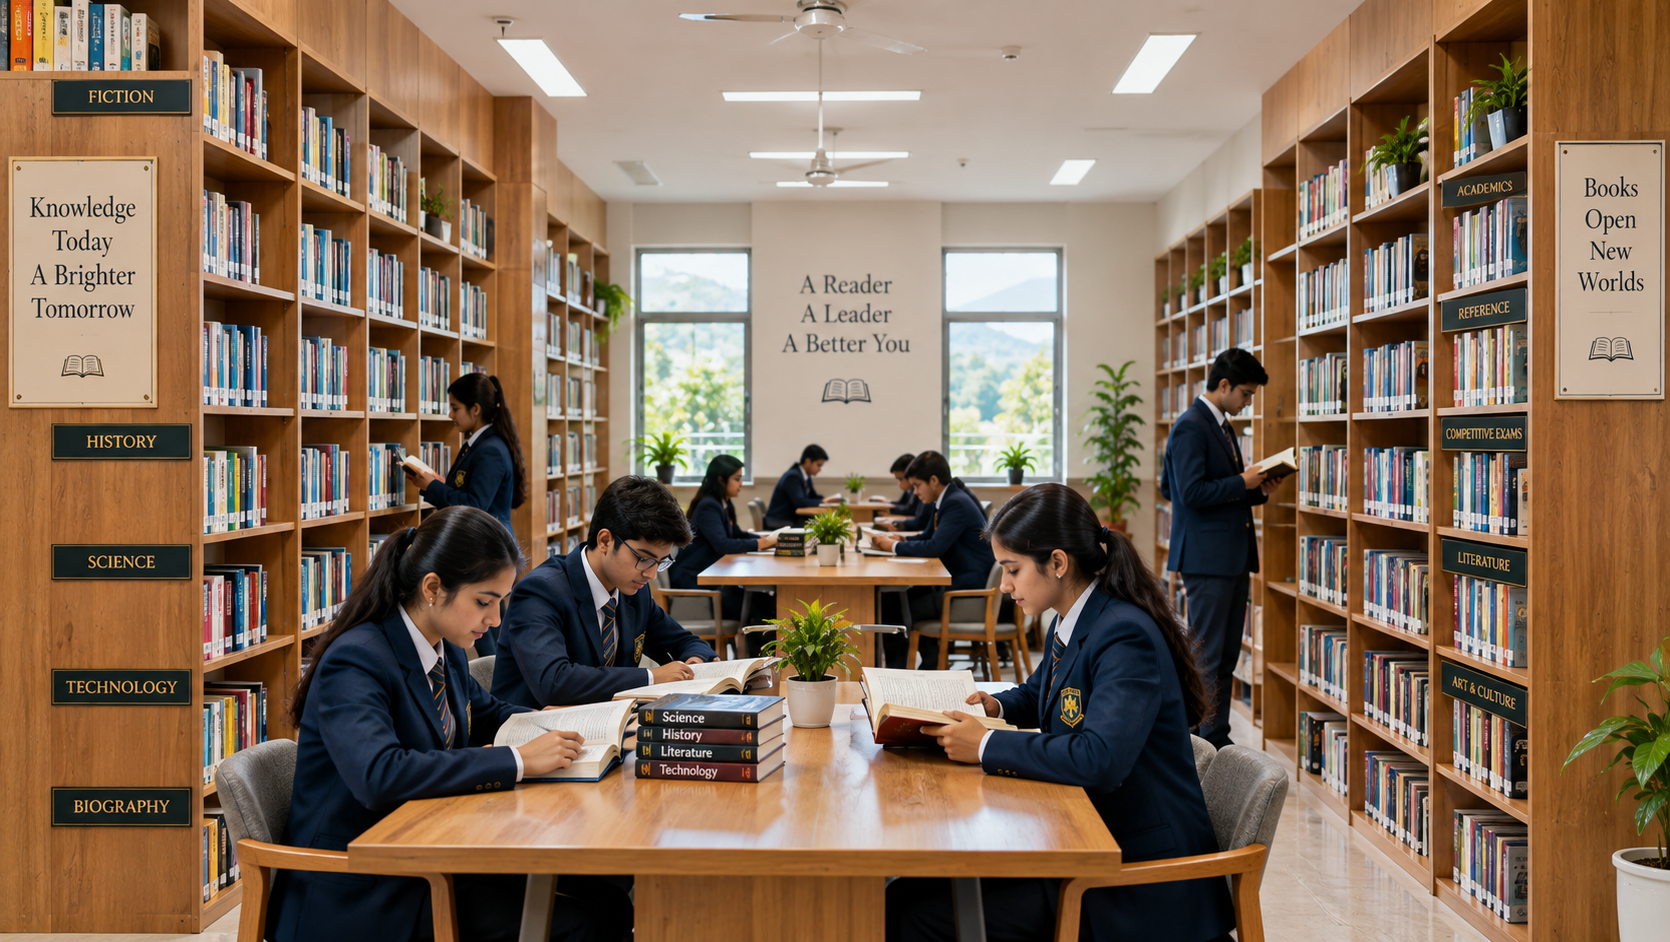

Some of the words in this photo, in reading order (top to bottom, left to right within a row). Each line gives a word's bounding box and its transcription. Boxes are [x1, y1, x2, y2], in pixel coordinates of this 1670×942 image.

[88, 89, 154, 104] FICTION
[1456, 180, 1513, 197] ACADEMICS
[1584, 175, 1639, 198] Books
[29, 195, 136, 223] Knowledge
[1585, 208, 1637, 236] Open
[51, 229, 113, 256] Today
[1589, 240, 1633, 261] New
[30, 263, 47, 286] A
[54, 262, 136, 293] Brighter
[799, 274, 816, 294] A
[823, 273, 893, 294] Reader
[1577, 271, 1645, 292] Worlds
[30, 297, 135, 319] Tomorrow
[800, 303, 817, 323] A
[824, 302, 893, 323] Leader
[1458, 300, 1510, 320] REFERENCE
[782, 333, 798, 353] A
[806, 333, 867, 353] Better
[872, 333, 910, 353] You
[86, 434, 157, 449] HISTORY
[1445, 427, 1494, 440] COMPETITIVE
[1496, 427, 1523, 440] EXAMS
[87, 554, 156, 569] SCIENCE
[1457, 551, 1511, 572] LITERATURE
[65, 680, 178, 695] TECHNOLOGY
[1452, 675, 1468, 691] ART
[1469, 682, 1476, 695] &
[1477, 685, 1517, 710] CULTURE
[662, 711, 705, 724] Science
[662, 728, 703, 743] History
[661, 745, 713, 759] Literature
[659, 763, 718, 780] Technology
[73, 799, 171, 814] BIOGRAPHY
